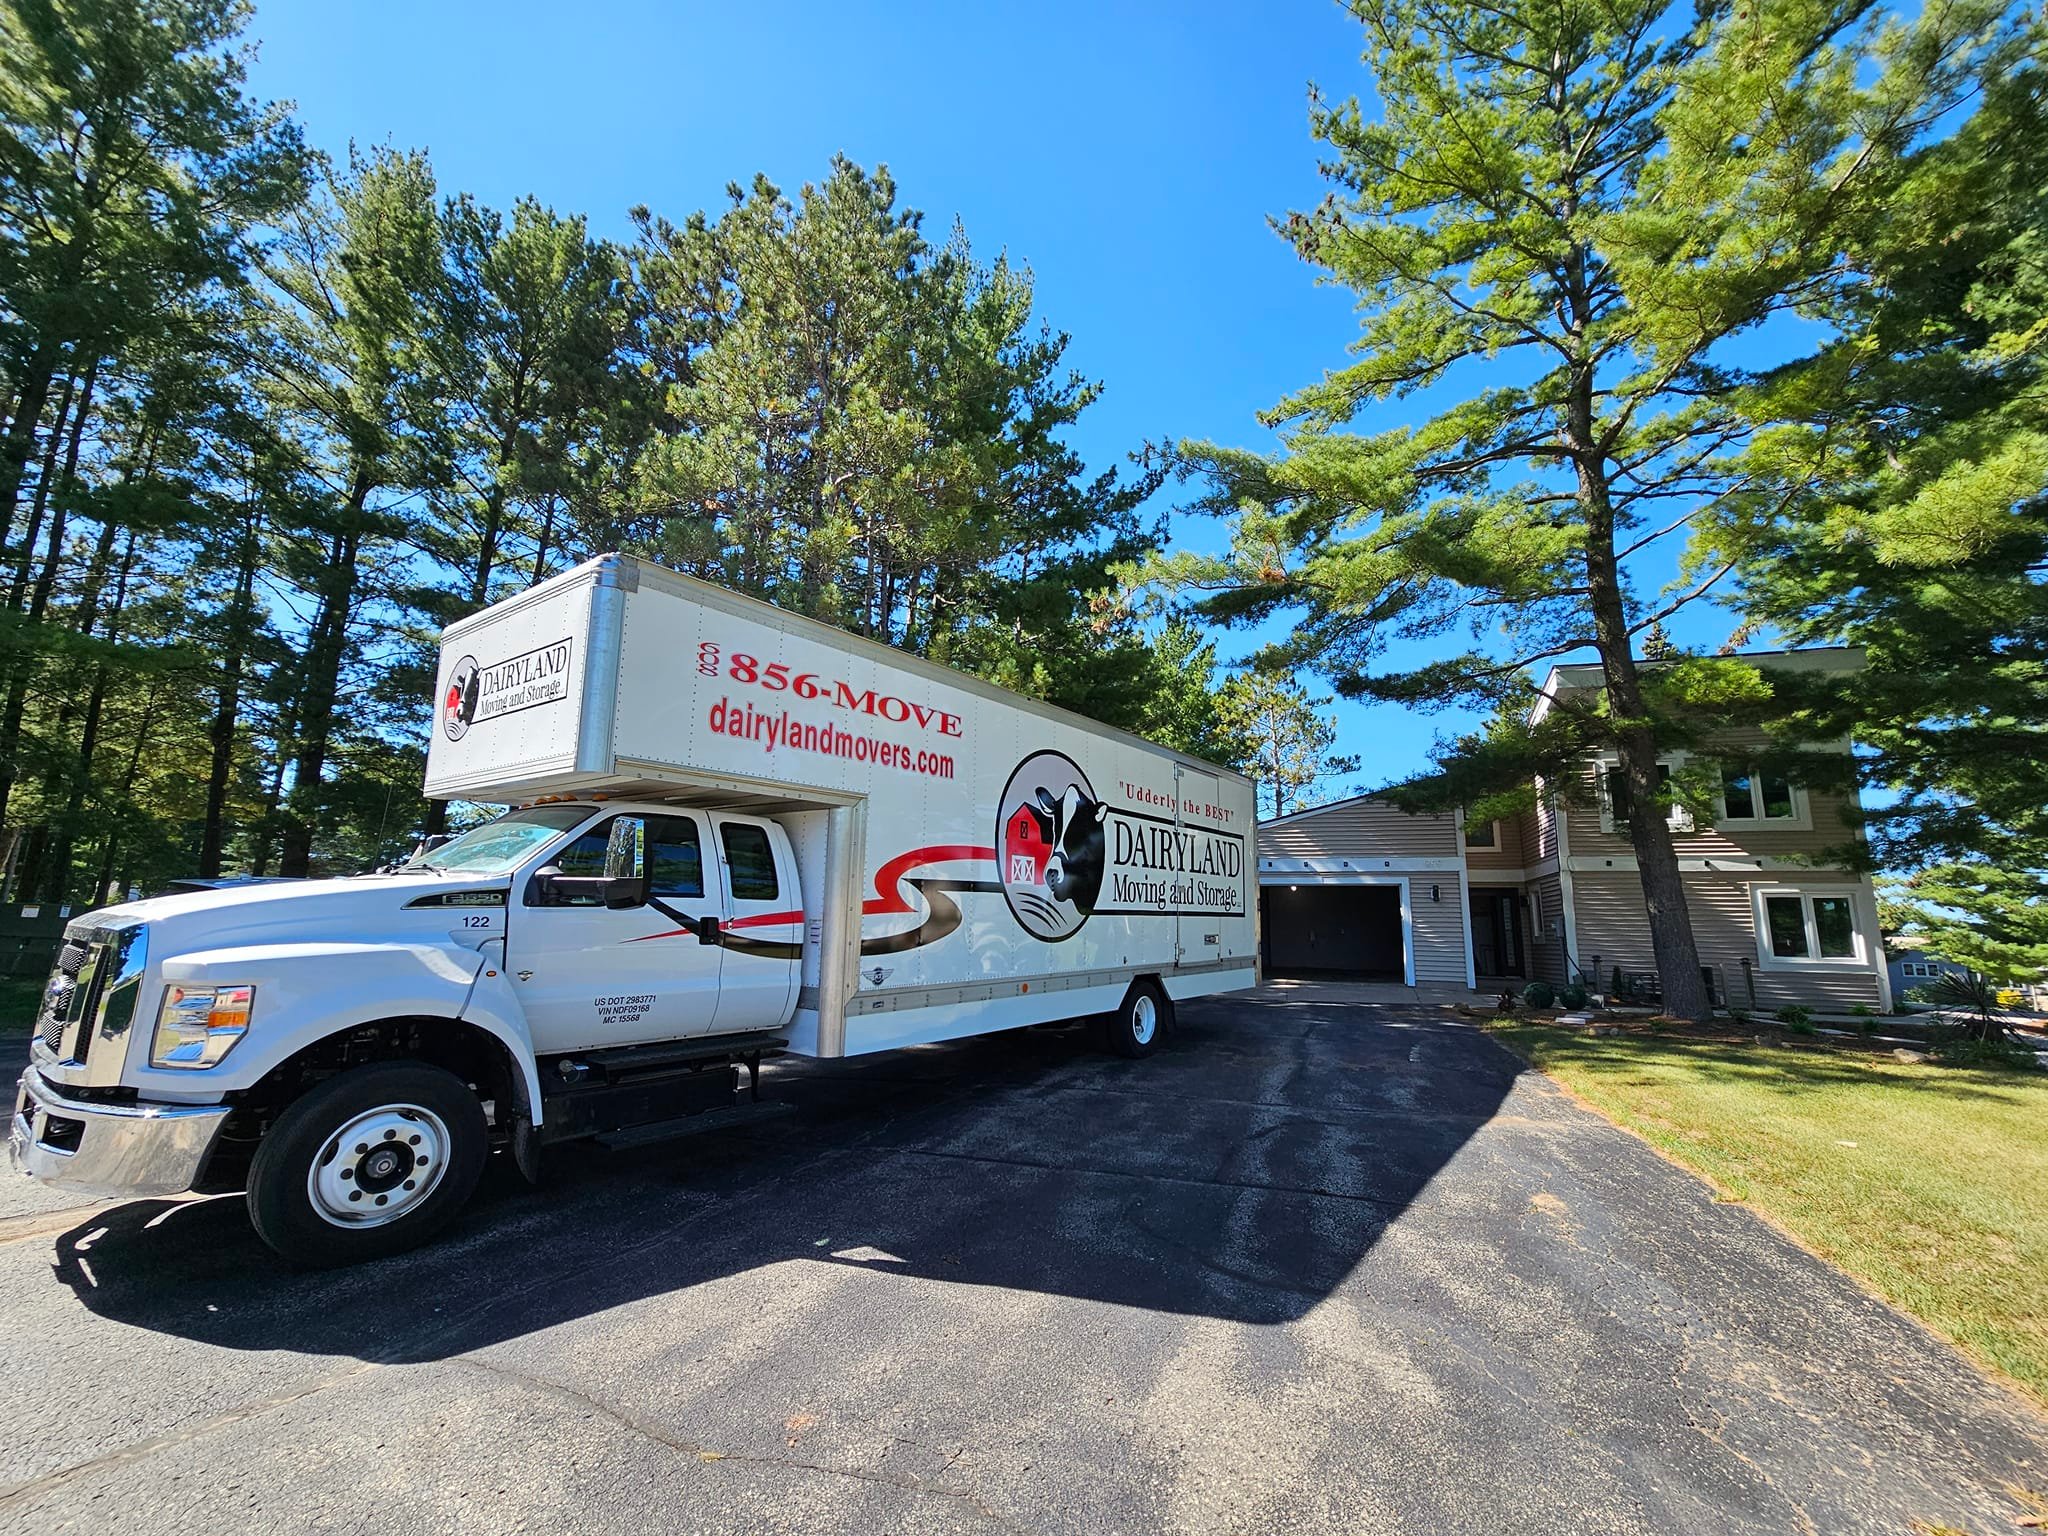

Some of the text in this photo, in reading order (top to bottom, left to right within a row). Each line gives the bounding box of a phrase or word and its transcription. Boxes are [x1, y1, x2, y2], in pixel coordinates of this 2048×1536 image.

[482, 645, 567, 696] DAIRYLAND
[480, 679, 561, 717] Moving and Storage
[698, 642, 963, 738] 608 856-MOVE
[709, 696, 955, 779] dairylandmovers.com
[1183, 800, 1201, 815] the
[1113, 819, 1240, 878] DAIRYLAND
[1113, 873, 1237, 911] Moving and Storage
[462, 916, 490, 928] 122
[594, 997, 606, 1006] US
[607, 996, 625, 1006] DOT
[598, 1007, 612, 1016] VIN
[602, 1015, 616, 1024] MC
